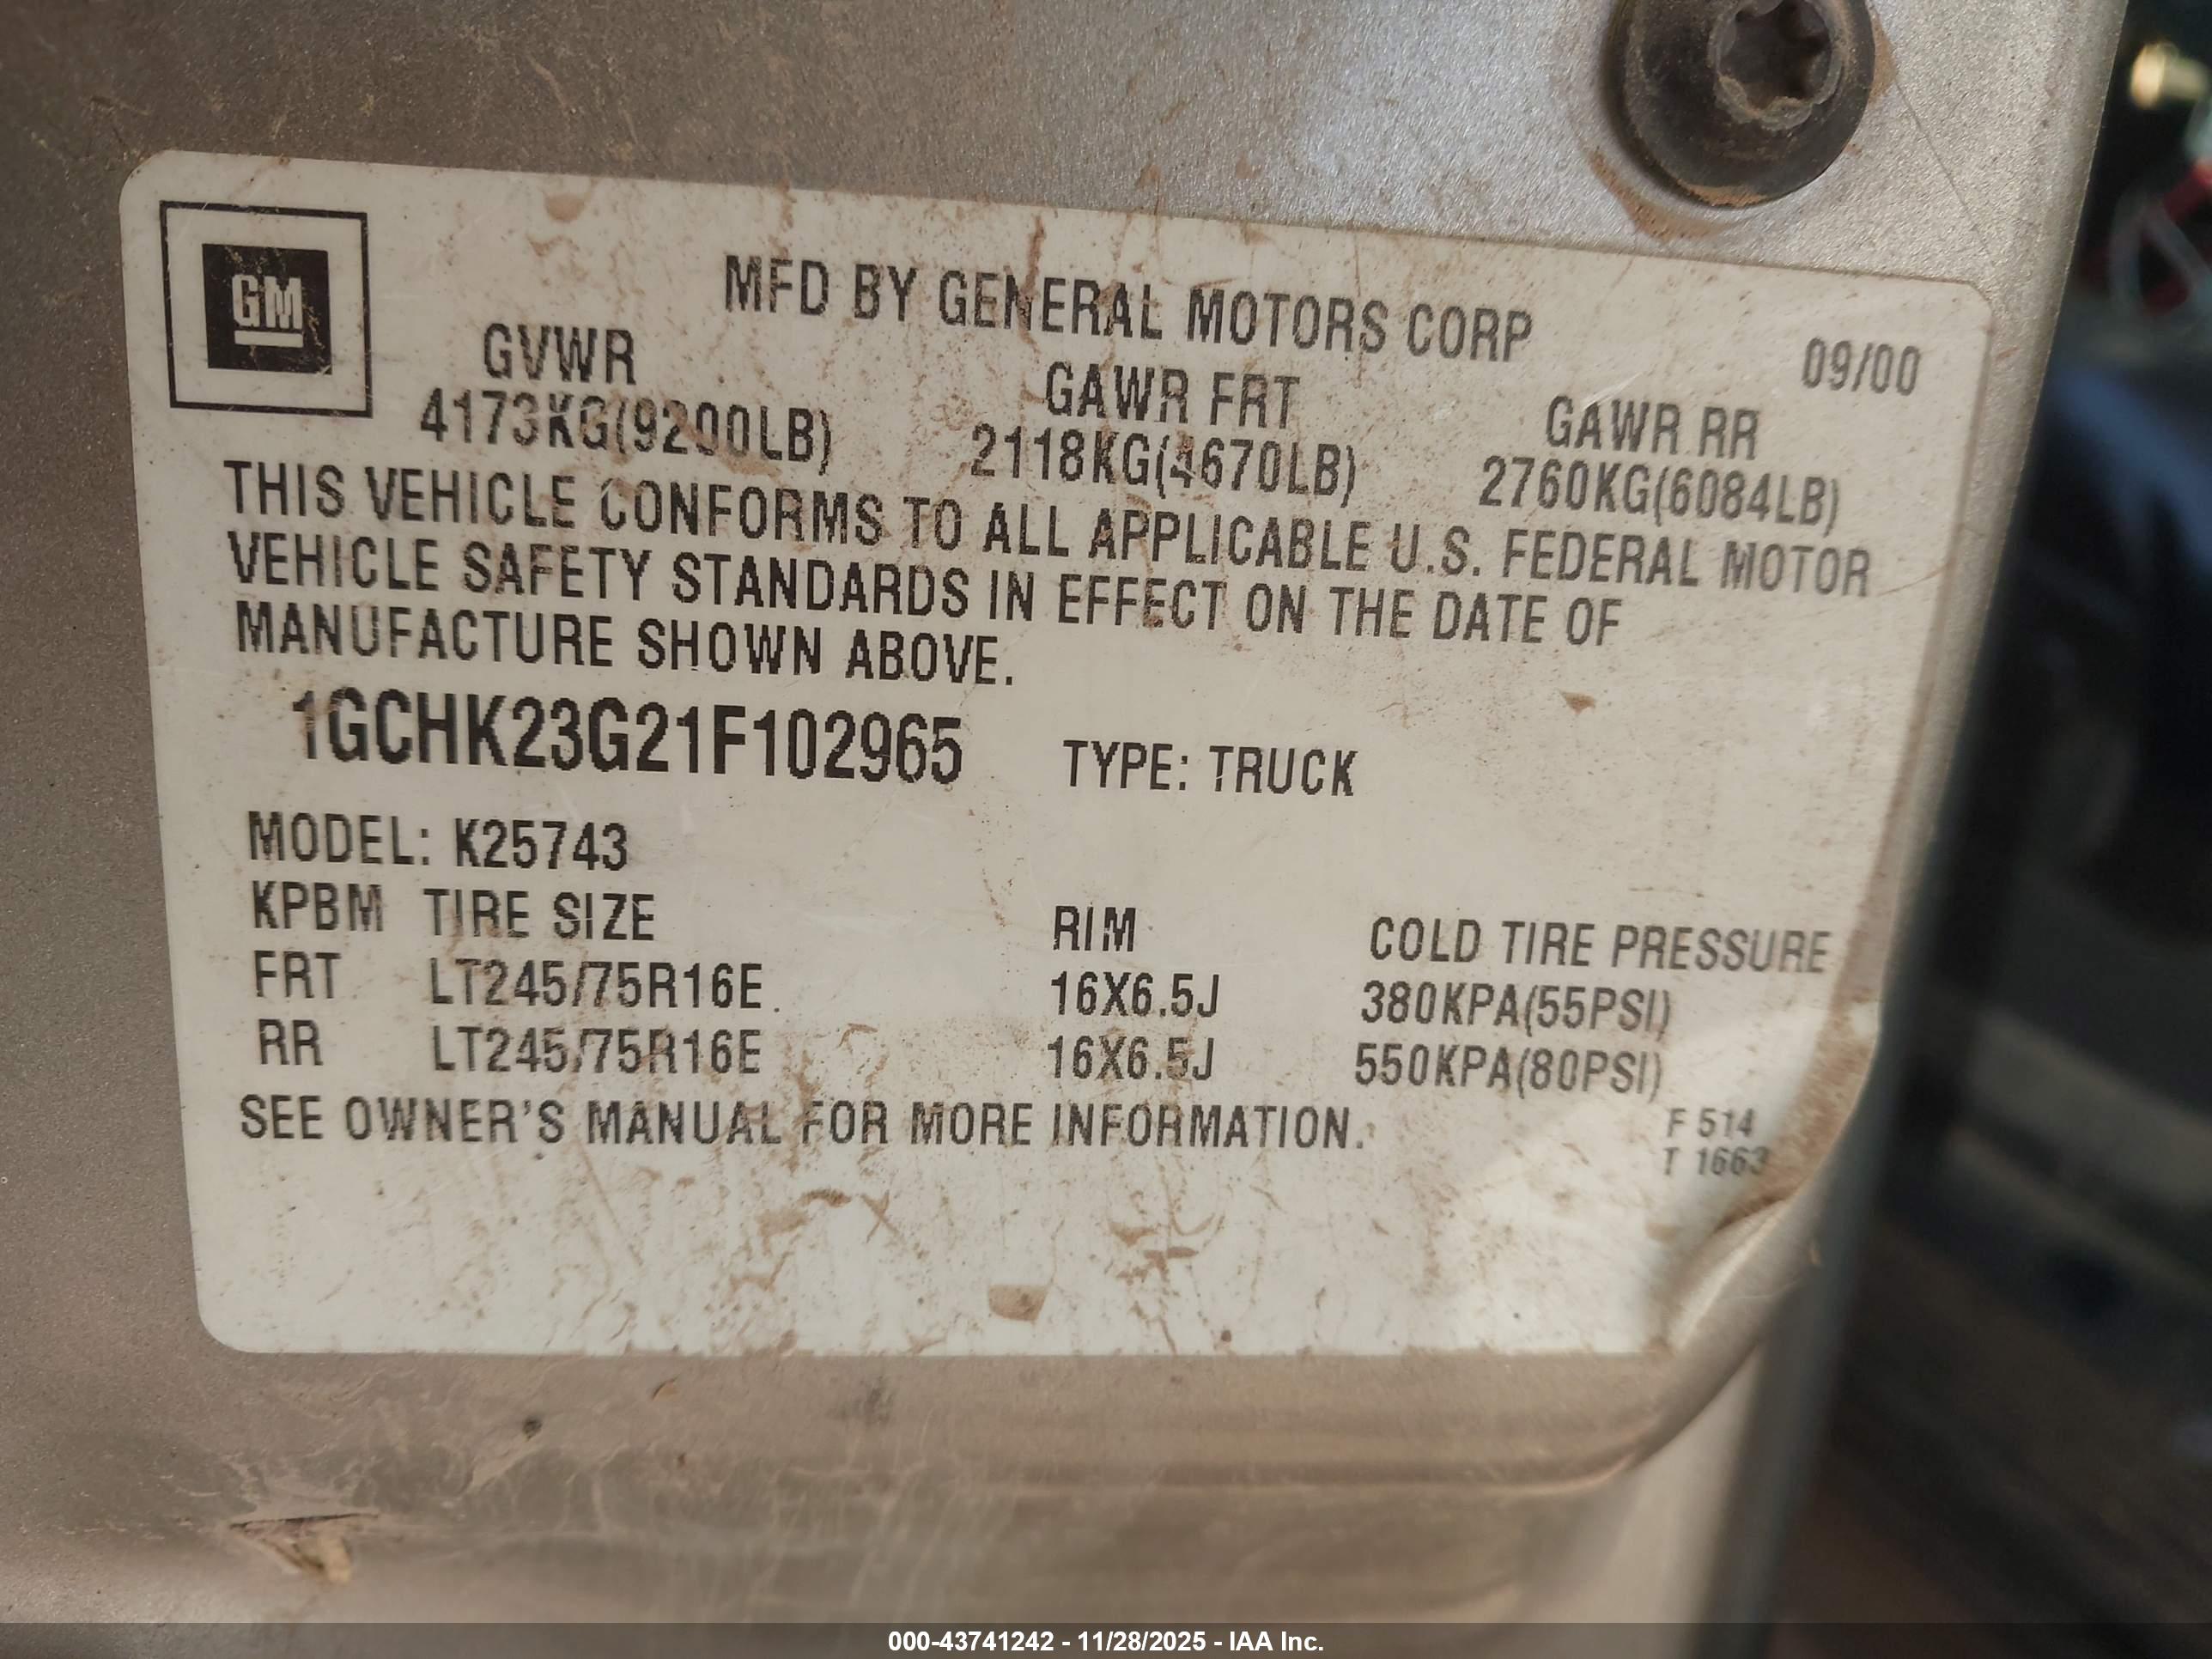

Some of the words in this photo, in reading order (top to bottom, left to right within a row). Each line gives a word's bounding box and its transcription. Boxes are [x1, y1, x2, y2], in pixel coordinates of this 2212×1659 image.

[232, 274, 302, 328] GM
[724, 254, 830, 317] MFD
[854, 260, 918, 322] BY
[938, 269, 1164, 340] GENERAL
[1187, 288, 1387, 356] MOTORS
[1407, 302, 1534, 363] CORP
[483, 322, 636, 385] GVWR
[1800, 337, 1922, 397] 09/00
[1044, 360, 1188, 424] GAWR
[1209, 372, 1300, 428] FRT
[420, 387, 830, 476] 4173KG(9200LB)
[1546, 395, 1681, 460] GAWR
[1697, 405, 1759, 462] RR
[971, 423, 1358, 507] 2118KG(4670LB)
[1479, 455, 1840, 536] 2760KG(6084LB)
[223, 459, 344, 517] THIS
[365, 465, 575, 529] VEHICLE
[601, 476, 883, 546] CONFORMS
[902, 495, 962, 550] TO
[982, 501, 1069, 556] ALL
[1088, 507, 1370, 572] APPLICABLE
[1390, 523, 1481, 578] U.S.
[1503, 528, 1698, 587] FEDERAL
[1719, 540, 1872, 598] MOTOR
[228, 531, 440, 592] VEHICLE
[462, 540, 653, 600] SAFETY
[672, 552, 969, 618] STANDARDS
[989, 569, 1034, 622] IN
[1058, 573, 1226, 629] EFFECT
[1247, 583, 1305, 634] ON
[1330, 586, 1413, 640] THE
[1434, 590, 1547, 645] DATE
[1566, 597, 1621, 647] OF
[237, 600, 613, 667] MANUFACTURE
[636, 617, 823, 677] SHOWN
[845, 632, 1013, 687] ABOVE.
[292, 689, 963, 785] 1GCHK23G21F102965
[1063, 739, 1189, 793] TYPE:
[1209, 745, 1358, 797] TRUCK
[247, 810, 430, 867] MODEL:
[454, 817, 629, 871] K25743
[251, 880, 384, 933] KPBM
[422, 887, 531, 940] TIRE
[552, 892, 654, 941] SIZE
[1054, 905, 1138, 953] RIM
[1369, 917, 1480, 964] COLD
[1501, 921, 1595, 968] TIRE
[1610, 924, 1833, 974] PRESSURE
[254, 951, 342, 1000] FRT
[428, 957, 763, 1010] LT245/75R16E
[1050, 972, 1220, 1020] 16X6.5J
[1360, 980, 1673, 1038] 380KPA(55PSI)
[258, 1018, 324, 1068] RR
[434, 1024, 762, 1075] LT245/75R16E
[1045, 1036, 1215, 1082] 16X6.5J
[1353, 1042, 1664, 1100] 550KPA(80PSI)
[240, 1094, 323, 1141] SEE
[344, 1095, 565, 1146] OWNER'S
[586, 1097, 783, 1146] MANUAL
[801, 1100, 890, 1146] FOR
[910, 1101, 1032, 1147] MORE
[1052, 1103, 1365, 1151] INFORMATION.
[1667, 1108, 1686, 1138] F
[1697, 1108, 1754, 1138] 514
[1664, 1146, 1680, 1176] T
[1696, 1146, 1771, 1176] 1663
